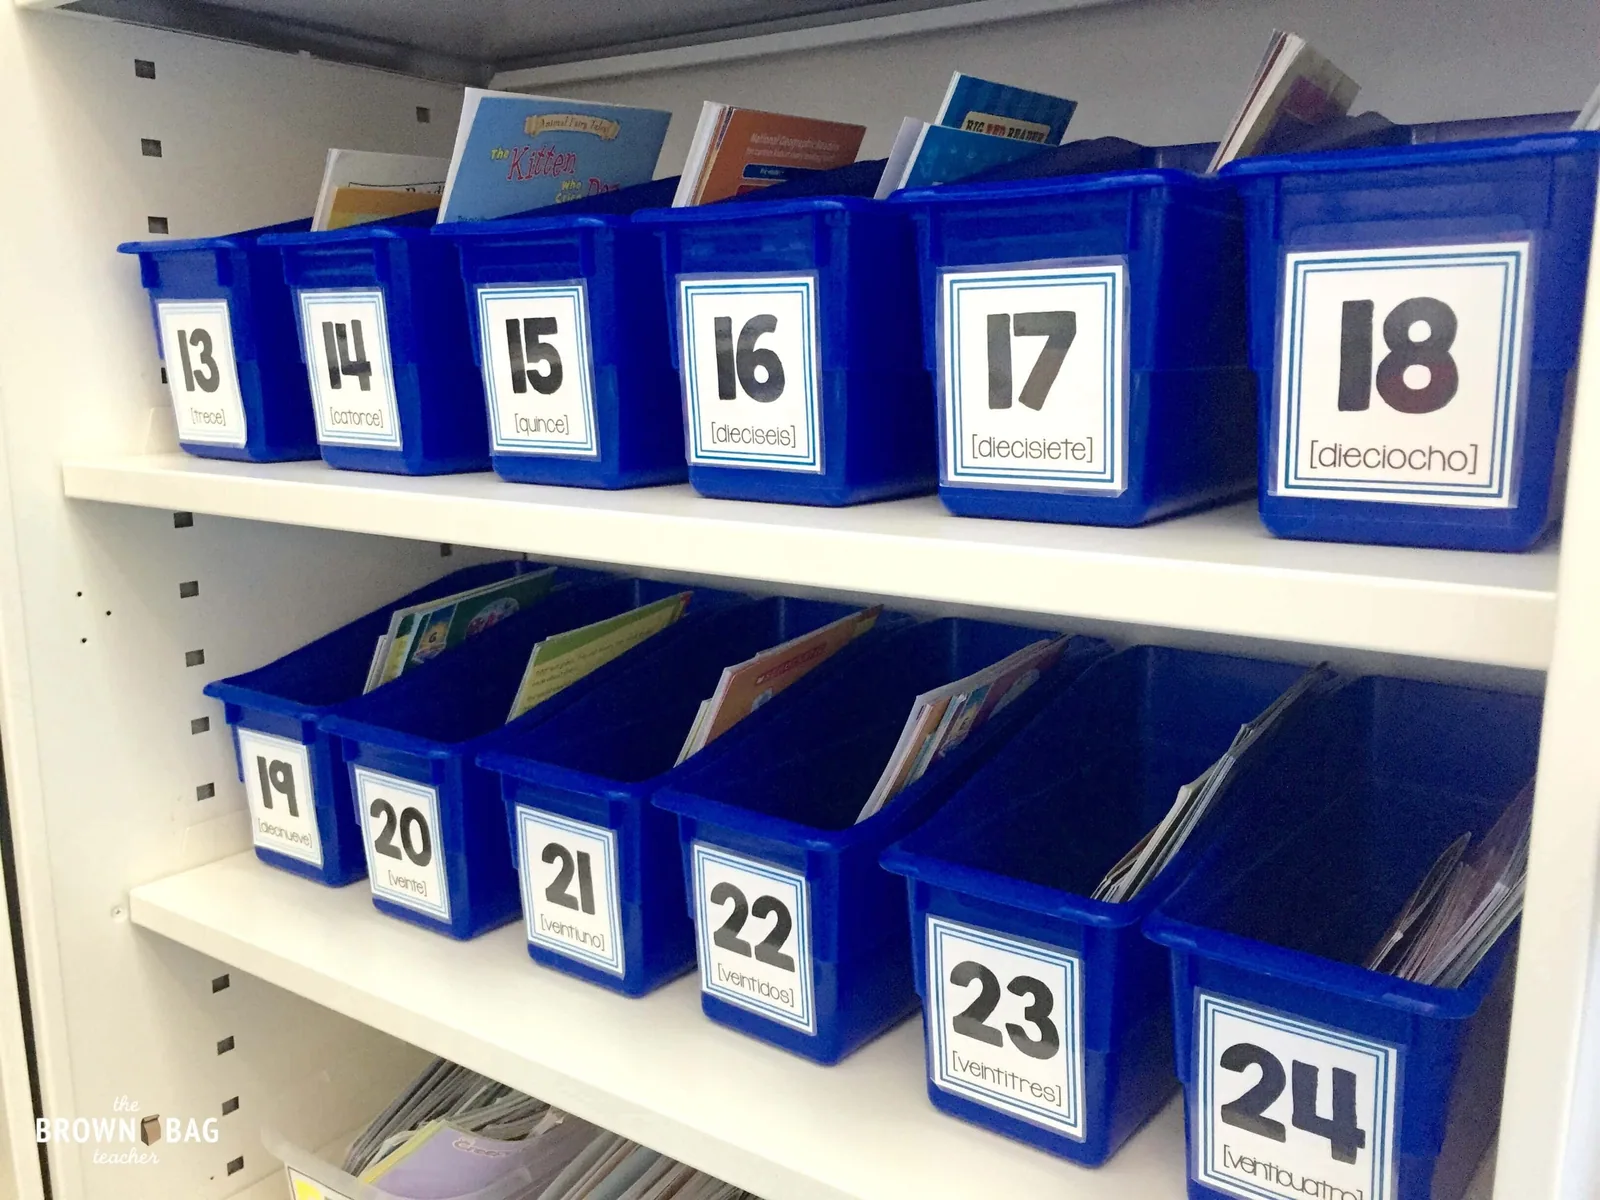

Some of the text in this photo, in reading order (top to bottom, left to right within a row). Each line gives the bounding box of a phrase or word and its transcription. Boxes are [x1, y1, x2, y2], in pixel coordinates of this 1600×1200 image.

[491, 144, 576, 180] The Kitten
[177, 327, 220, 393] 13
[322, 319, 372, 392] 14
[505, 316, 563, 395] 15
[714, 313, 786, 403] 16
[987, 310, 1077, 411] 17
[1338, 296, 1459, 414] 18
[190, 407, 226, 427] [trece]
[329, 406, 384, 429] [catorce]
[514, 413, 570, 435] [quince]
[711, 421, 796, 448] [dieciseis]
[972, 433, 1094, 464] [diecisiete]
[1309, 440, 1478, 476] [dieciocho]
[256, 755, 300, 818] 19
[369, 797, 432, 867] 20
[387, 869, 428, 898] [veinte]
[541, 842, 596, 916] 21
[540, 913, 605, 952] [veintiuno]
[710, 881, 796, 973] 22
[717, 962, 795, 1008] [veintidos]
[949, 960, 1060, 1061] 23
[952, 1050, 1062, 1107] [veintitres]
[1219, 1042, 1366, 1165] 24
